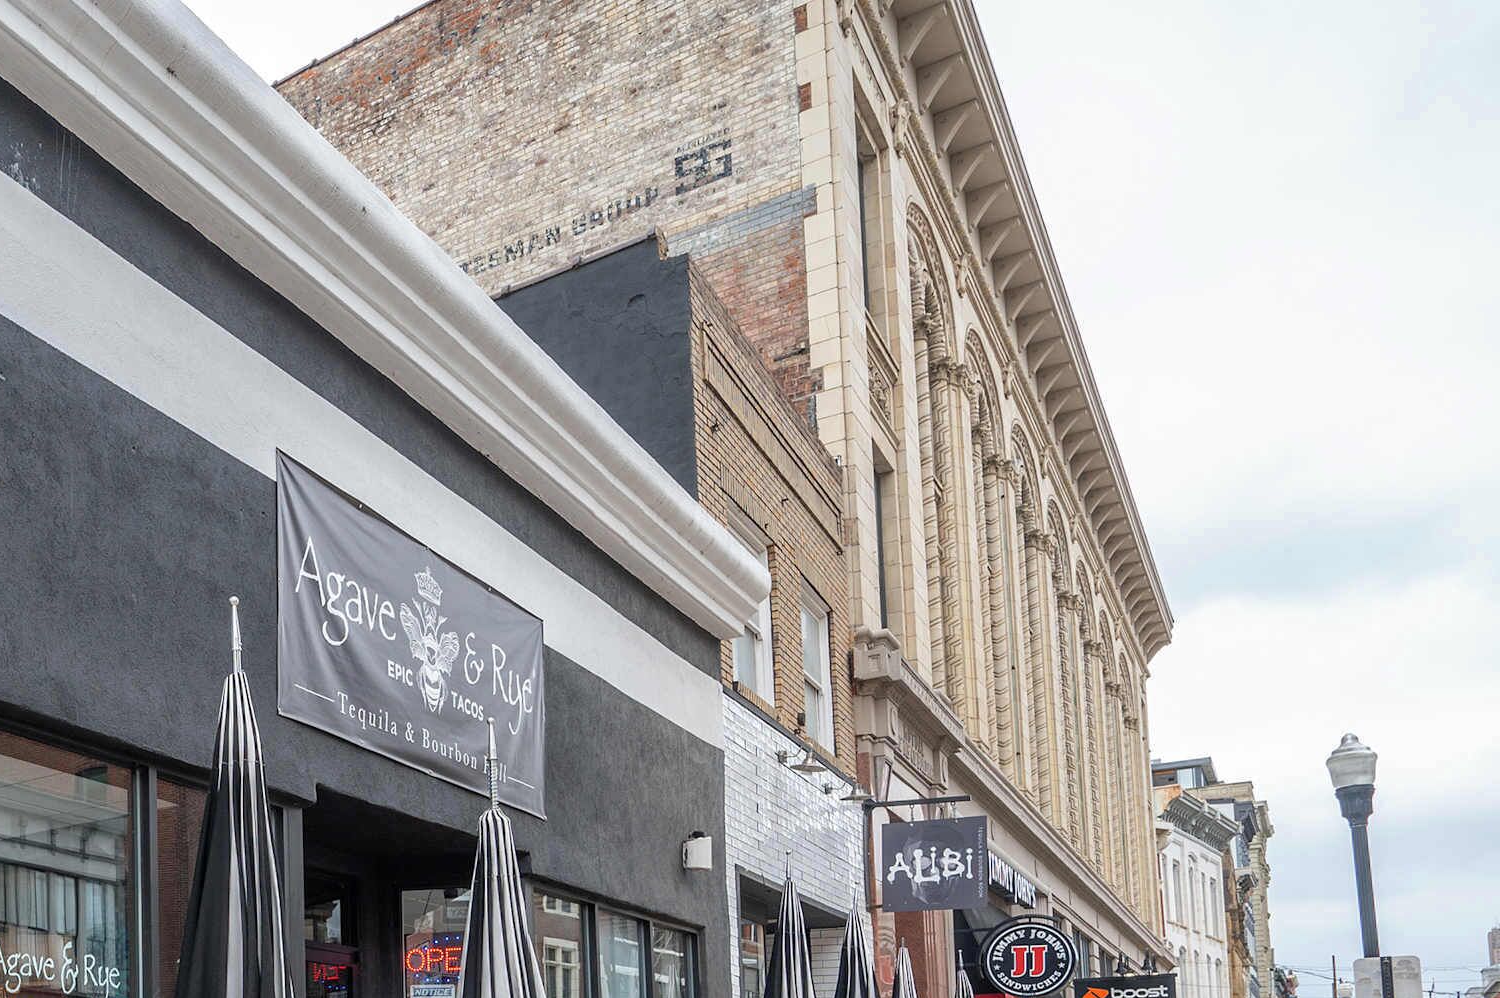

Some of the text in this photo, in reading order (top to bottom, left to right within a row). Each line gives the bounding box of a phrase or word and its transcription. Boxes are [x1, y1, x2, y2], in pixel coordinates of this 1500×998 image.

[295, 535, 533, 735] Agave & Rye
[387, 659, 484, 722] EPIC TACOS
[337, 690, 506, 784] Tequila & Bourbon Hll
[405, 946, 462, 973] OPE
[992, 928, 1067, 962] JIMMY JOHN'S
[1011, 944, 1048, 978] JJ
[61, 940, 79, 995] &
[996, 970, 1062, 992] SANDWICHES
[413, 988, 453, 997] NOTICE
